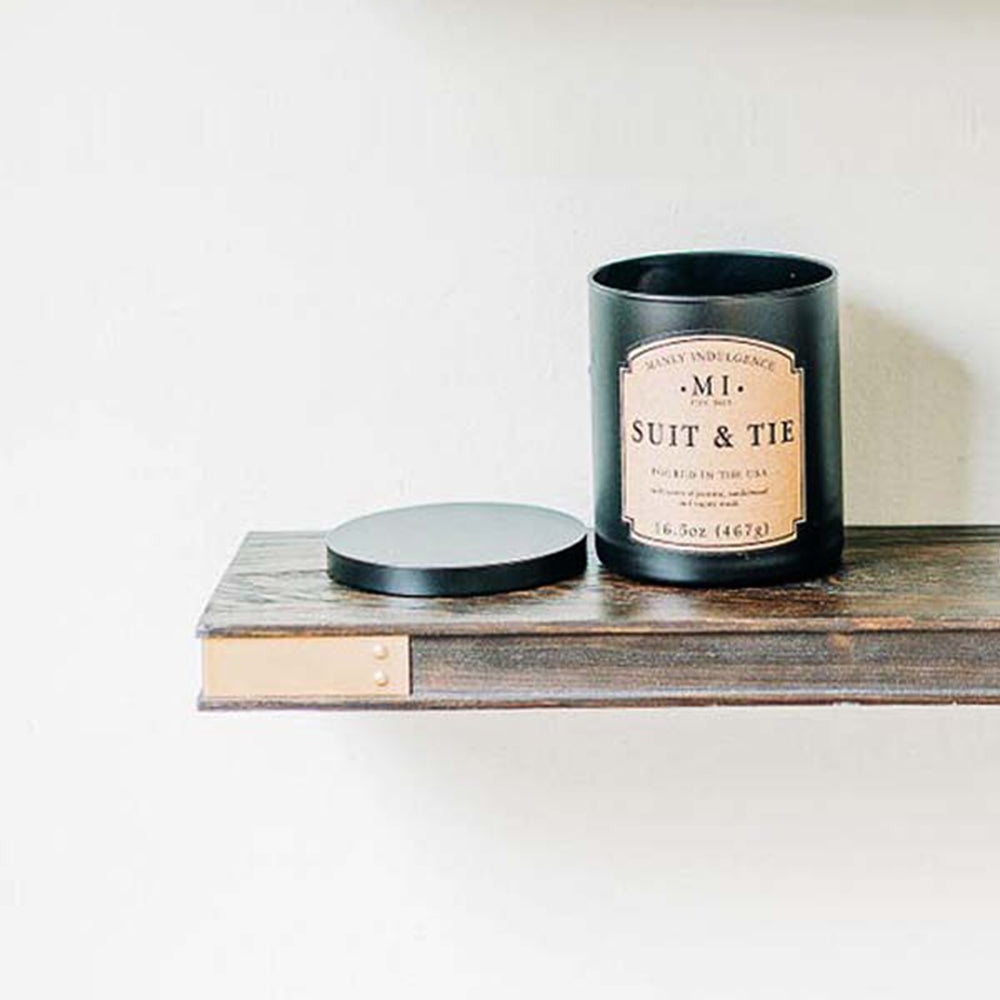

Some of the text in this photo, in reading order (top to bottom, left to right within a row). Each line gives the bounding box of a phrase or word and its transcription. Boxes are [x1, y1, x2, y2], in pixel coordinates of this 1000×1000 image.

[690, 351, 776, 373] INDULGENCE
[632, 420, 795, 448] SUIT & TIE
